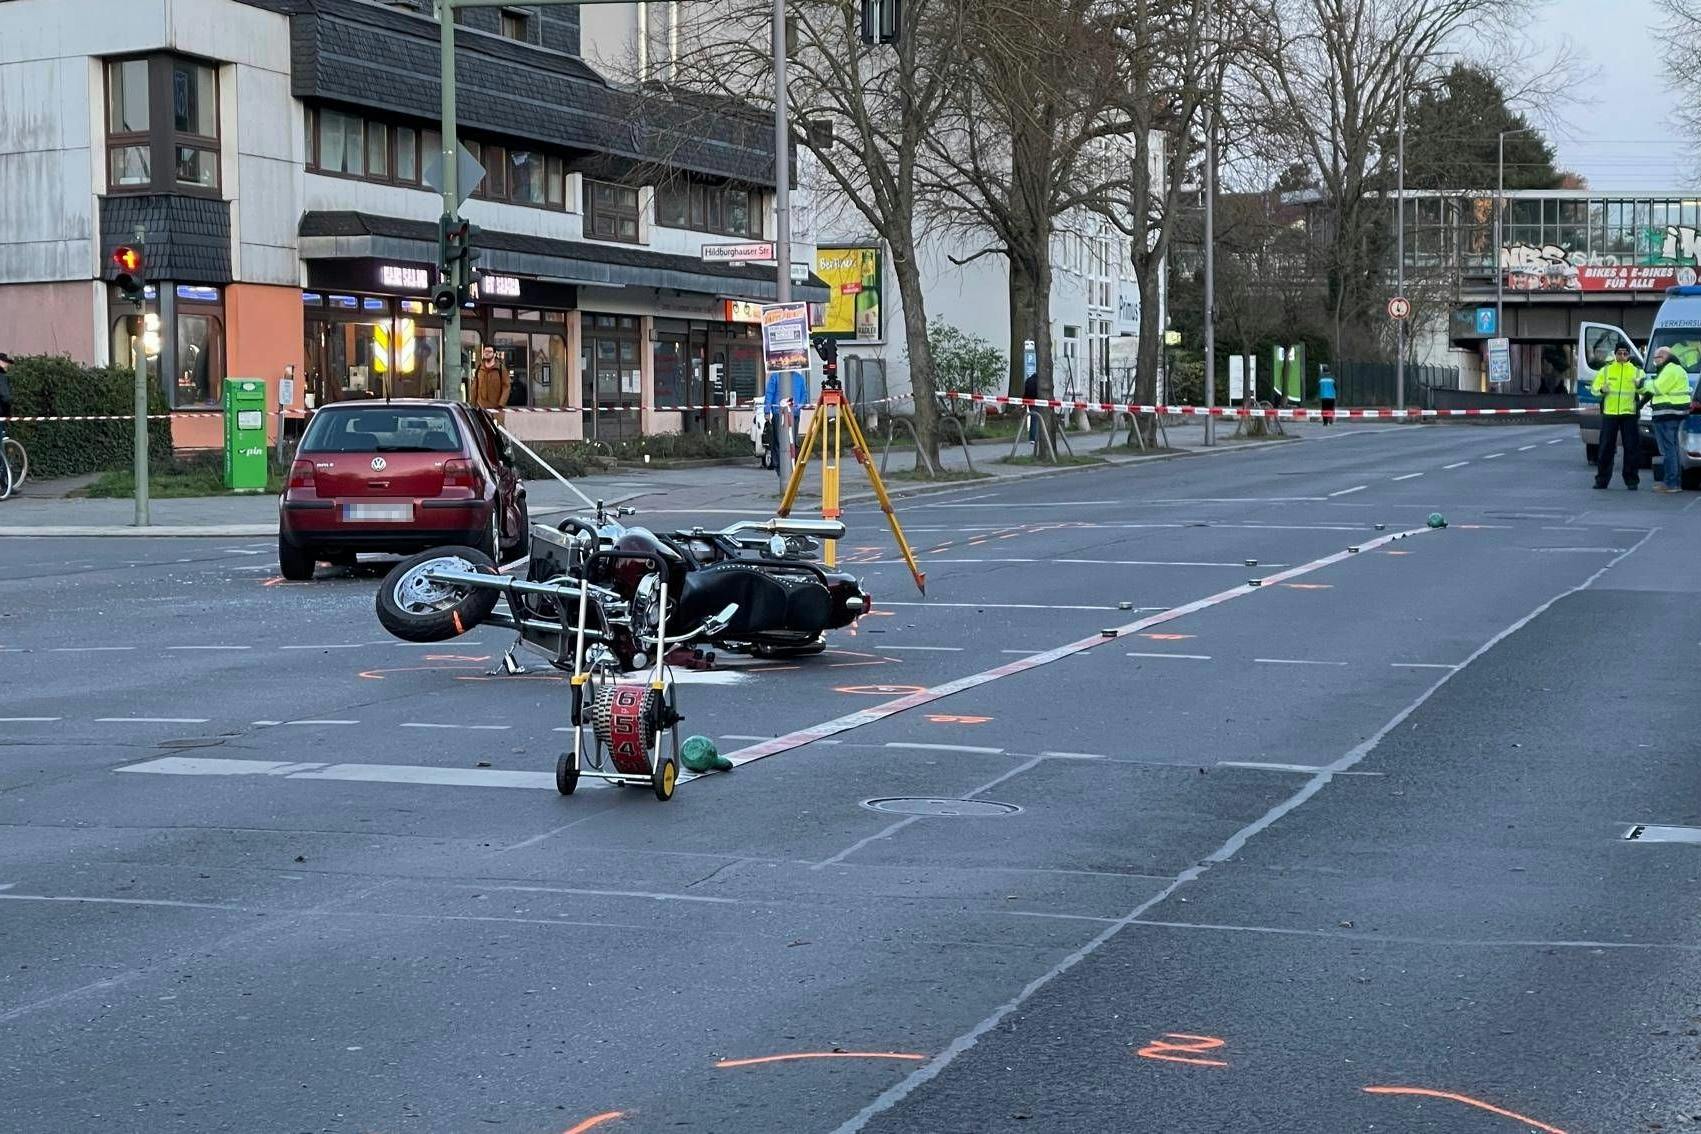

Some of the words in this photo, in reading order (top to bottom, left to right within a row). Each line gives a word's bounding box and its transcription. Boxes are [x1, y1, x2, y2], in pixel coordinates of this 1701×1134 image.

[705, 247, 757, 258] Hildburghauser
[1584, 267, 1618, 277] BIKES
[1618, 267, 1628, 277] &
[1631, 267, 1674, 278] E-BIKES
[1604, 277, 1627, 288] FÜR
[1629, 278, 1655, 288] ALLE
